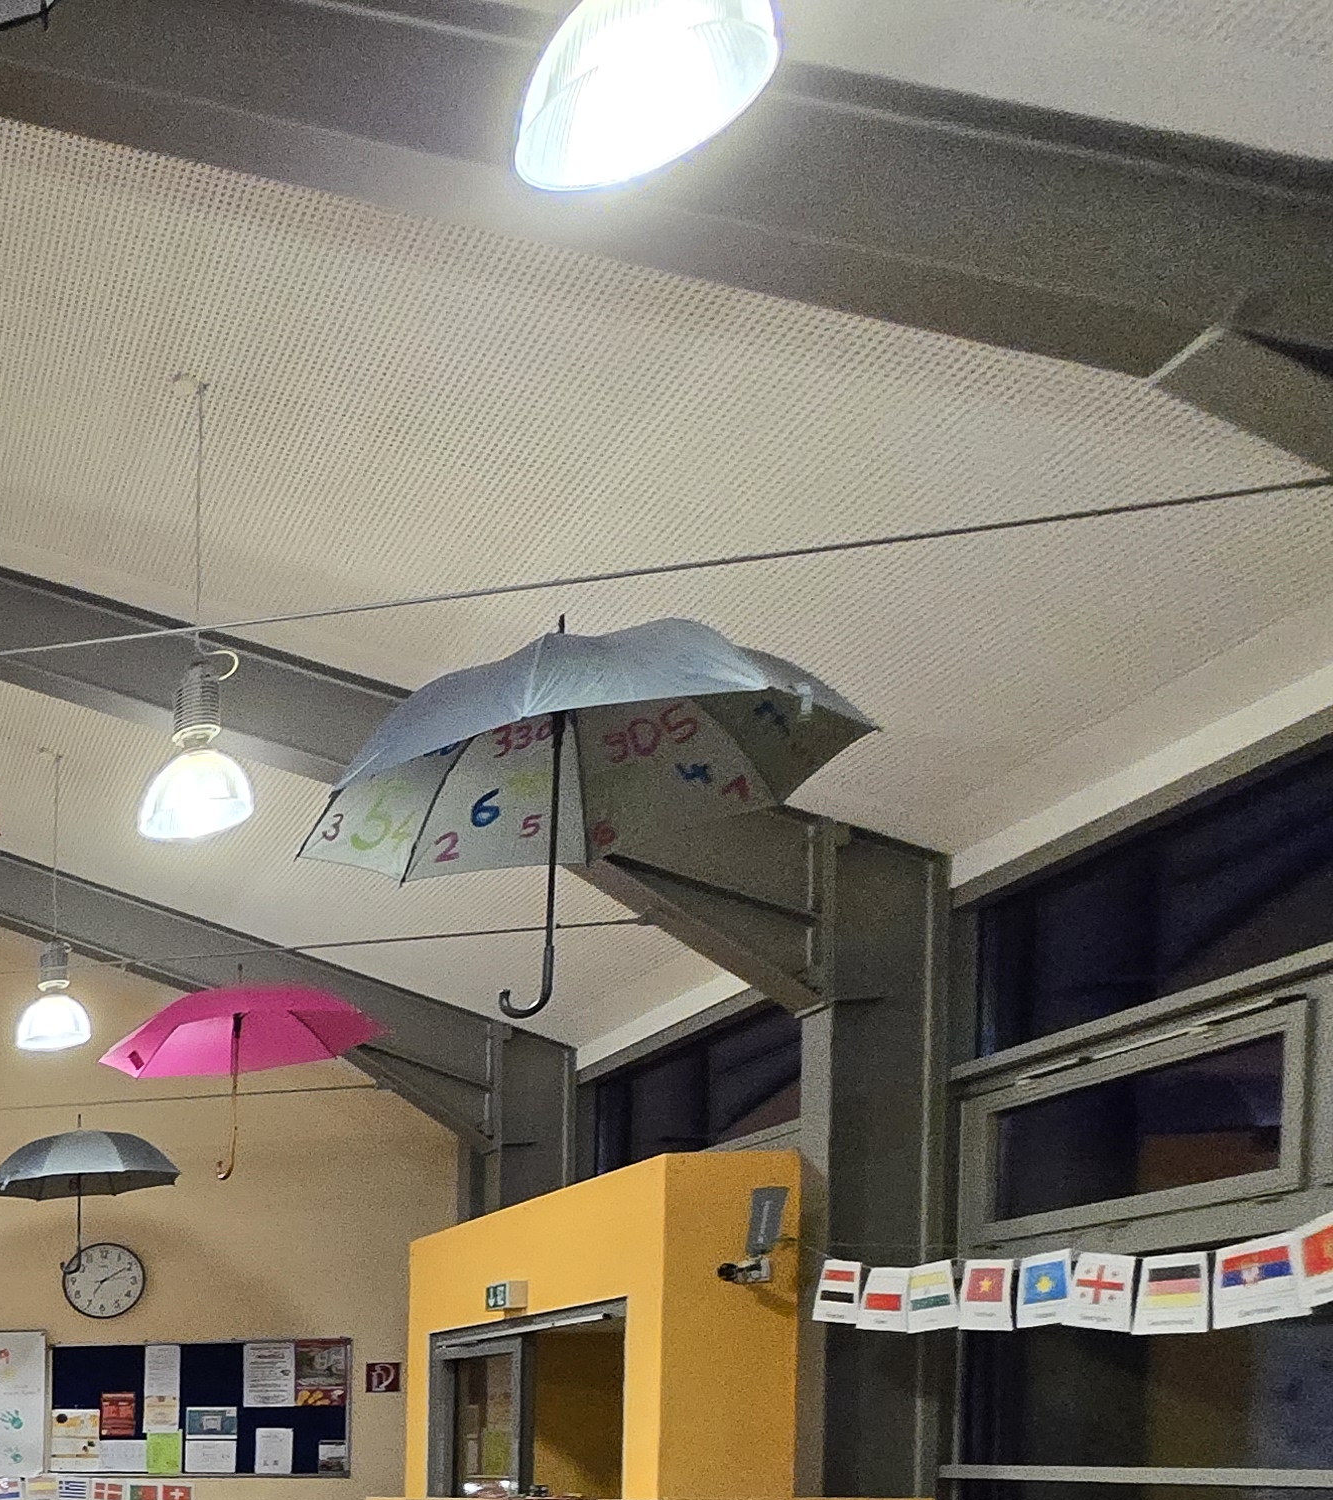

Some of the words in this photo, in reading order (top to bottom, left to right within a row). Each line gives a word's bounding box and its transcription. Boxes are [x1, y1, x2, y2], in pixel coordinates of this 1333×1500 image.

[471, 788, 500, 828] 6
[322, 813, 344, 841] 3
[519, 814, 543, 838] 5
[435, 831, 460, 863] 2
